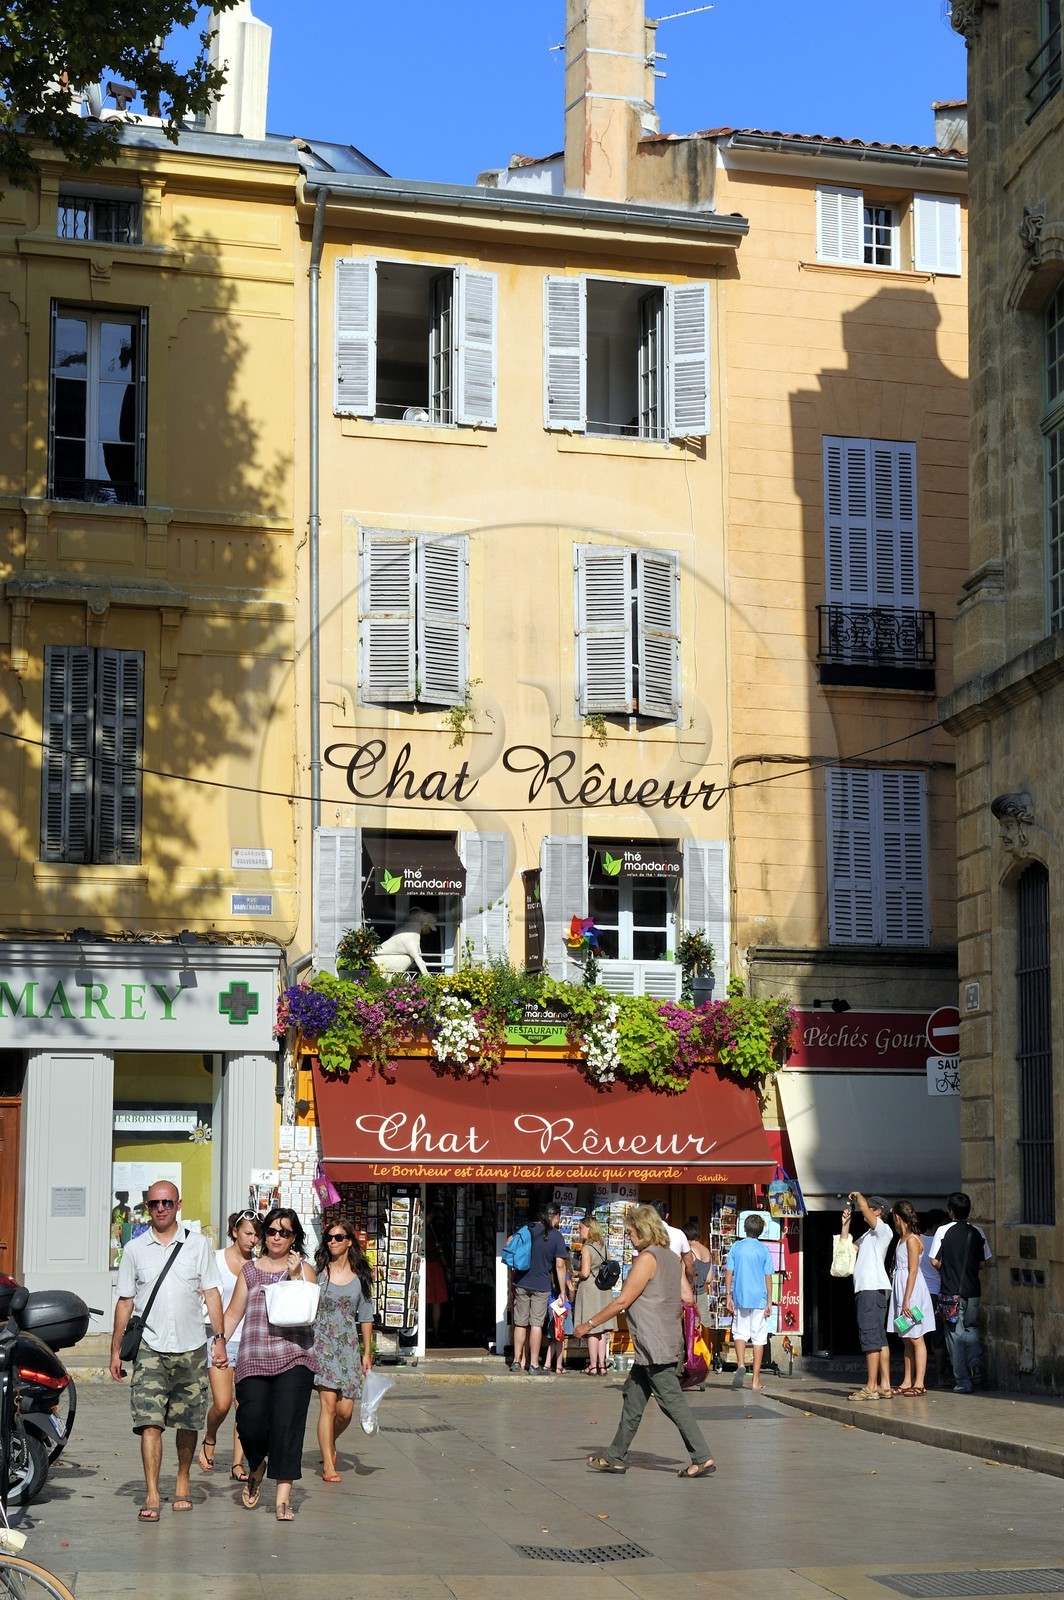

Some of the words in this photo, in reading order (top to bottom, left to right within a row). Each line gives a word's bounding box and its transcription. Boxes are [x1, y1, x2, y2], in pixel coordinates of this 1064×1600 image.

[323, 739, 479, 802] Chat
[502, 744, 726, 811] Rêveur
[624, 850, 642, 862] thé
[404, 867, 423, 879] thé
[624, 861, 680, 872] mandarine
[404, 879, 463, 889] mandarine
[0, 980, 189, 1021] MAREY
[803, 1025, 868, 1048] Péchés
[937, 1059, 962, 1070] SAU
[355, 1112, 490, 1153] Chat
[513, 1114, 717, 1155] Rêveur
[391, 1165, 451, 1177] Bonheur
[454, 1166, 476, 1177] est
[475, 1166, 511, 1178] dans
[546, 1166, 566, 1178] de
[566, 1166, 601, 1178] celui
[602, 1168, 627, 1181] qui
